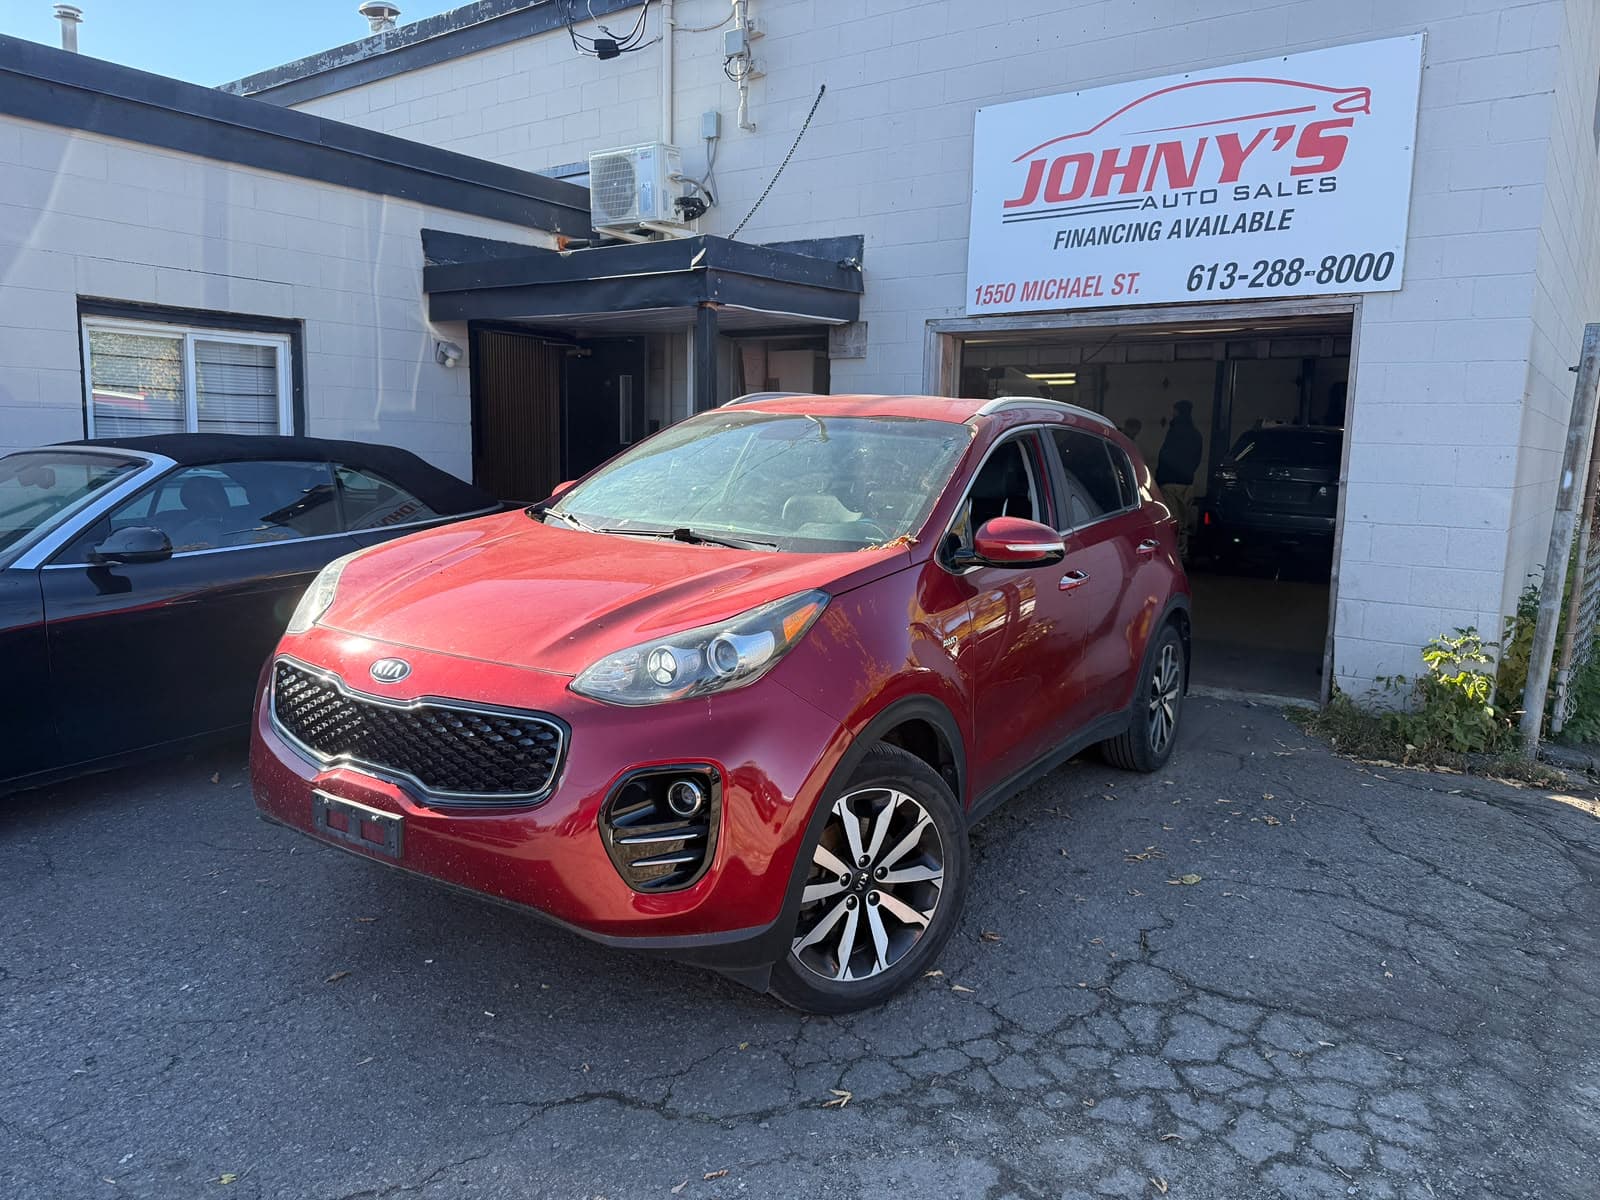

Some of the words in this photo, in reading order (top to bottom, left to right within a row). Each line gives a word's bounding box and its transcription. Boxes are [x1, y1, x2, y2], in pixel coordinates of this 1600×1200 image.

[1003, 117, 1354, 208] JOHNY'S
[1141, 188, 1218, 210] AUTO
[1233, 176, 1337, 201] SALES
[1053, 220, 1162, 250] FINANCING
[1167, 208, 1295, 239] AVAILABLE
[975, 283, 1015, 305] 1550
[1020, 275, 1104, 302] MICHAEL
[1111, 272, 1140, 296] ST.
[1186, 251, 1395, 292] 613-288-8000
[372, 660, 403, 678] KIA
[855, 872, 869, 891] KIA
